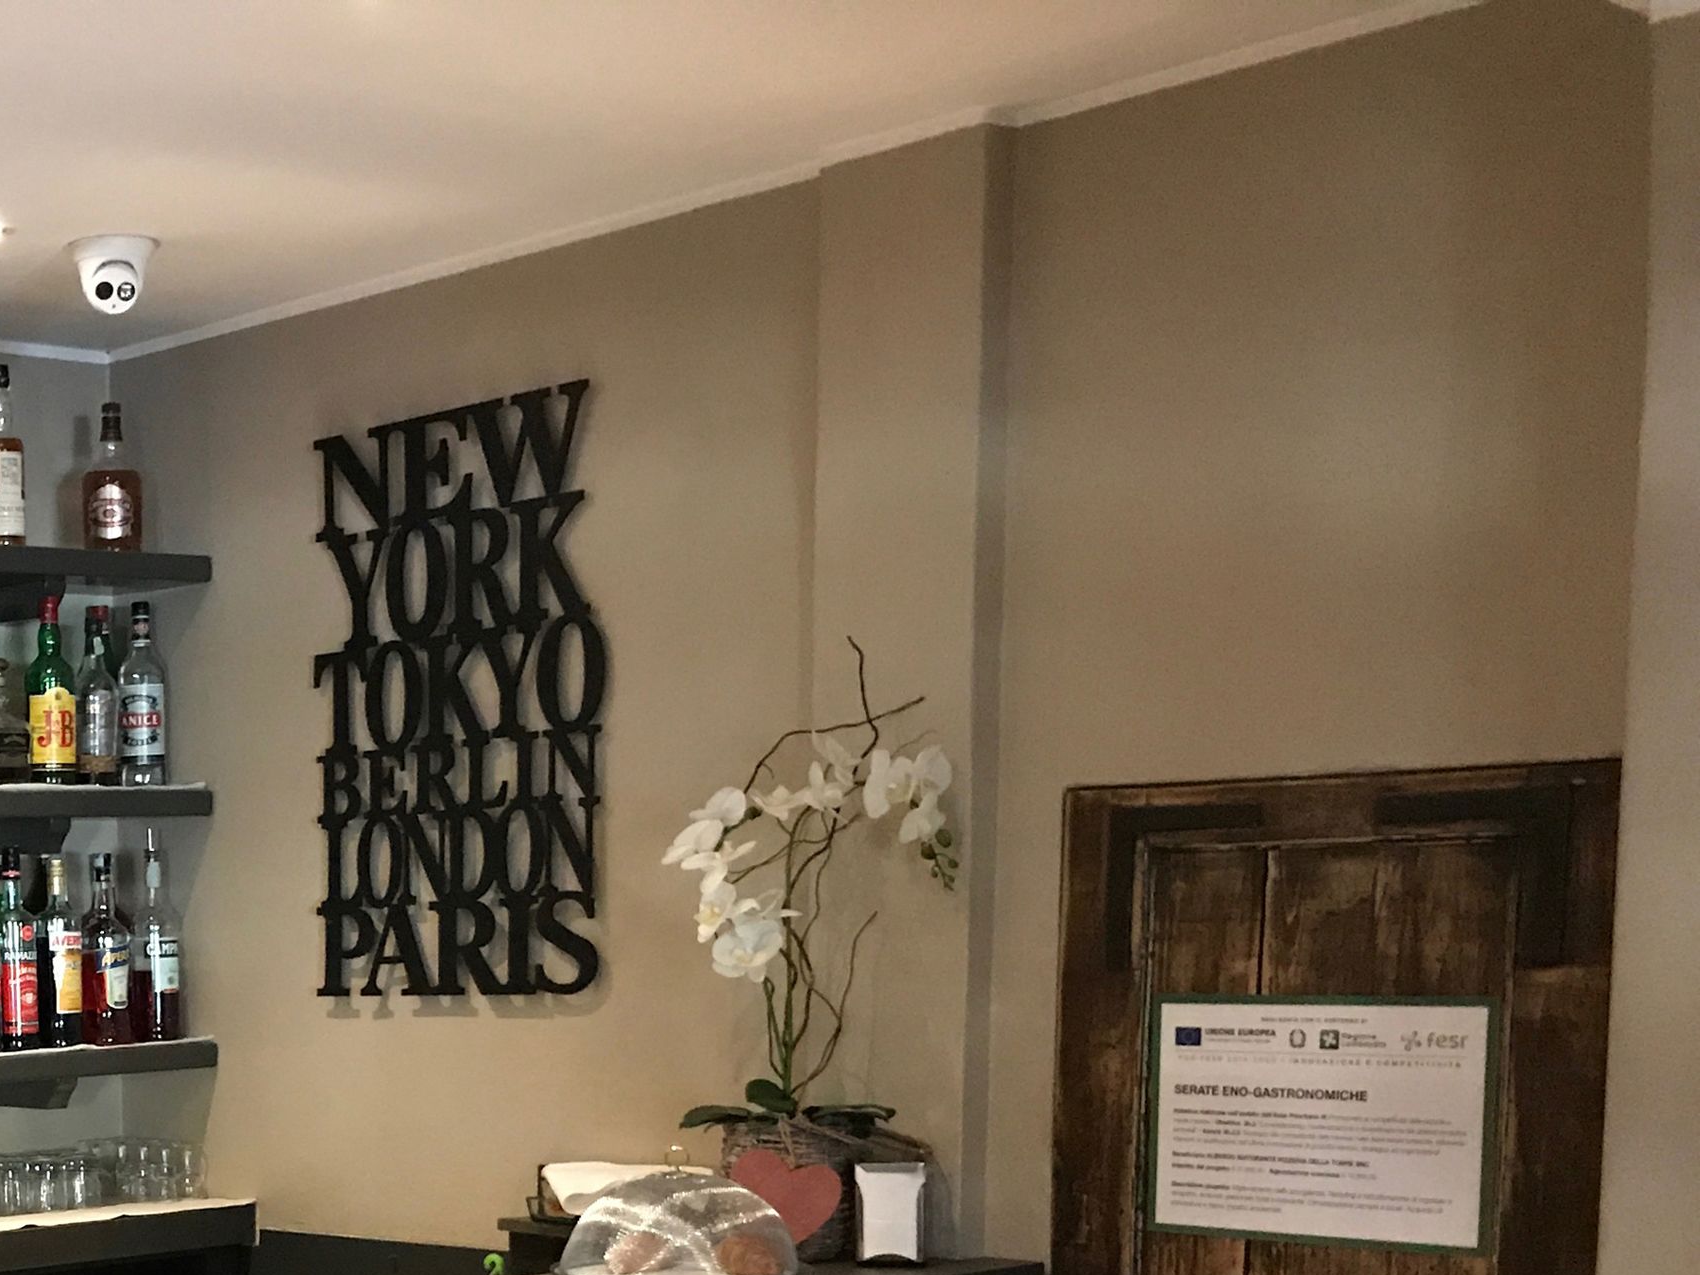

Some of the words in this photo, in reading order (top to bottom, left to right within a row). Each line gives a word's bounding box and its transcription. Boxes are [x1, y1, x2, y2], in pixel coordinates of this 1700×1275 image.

[313, 378, 590, 543] NEW
[326, 488, 593, 650] YORK
[121, 714, 159, 726] ANICE
[313, 613, 606, 756] TOKYO
[316, 723, 603, 826] BERLIN
[316, 797, 602, 911] LONDON
[315, 890, 600, 998] PARIS
[1237, 1027, 1277, 1037] EUROPEA
[1427, 1031, 1469, 1049] fesr
[1174, 1083, 1219, 1096] SERATE
[1222, 1085, 1368, 1102] ENO-GASTRONOMICHE
